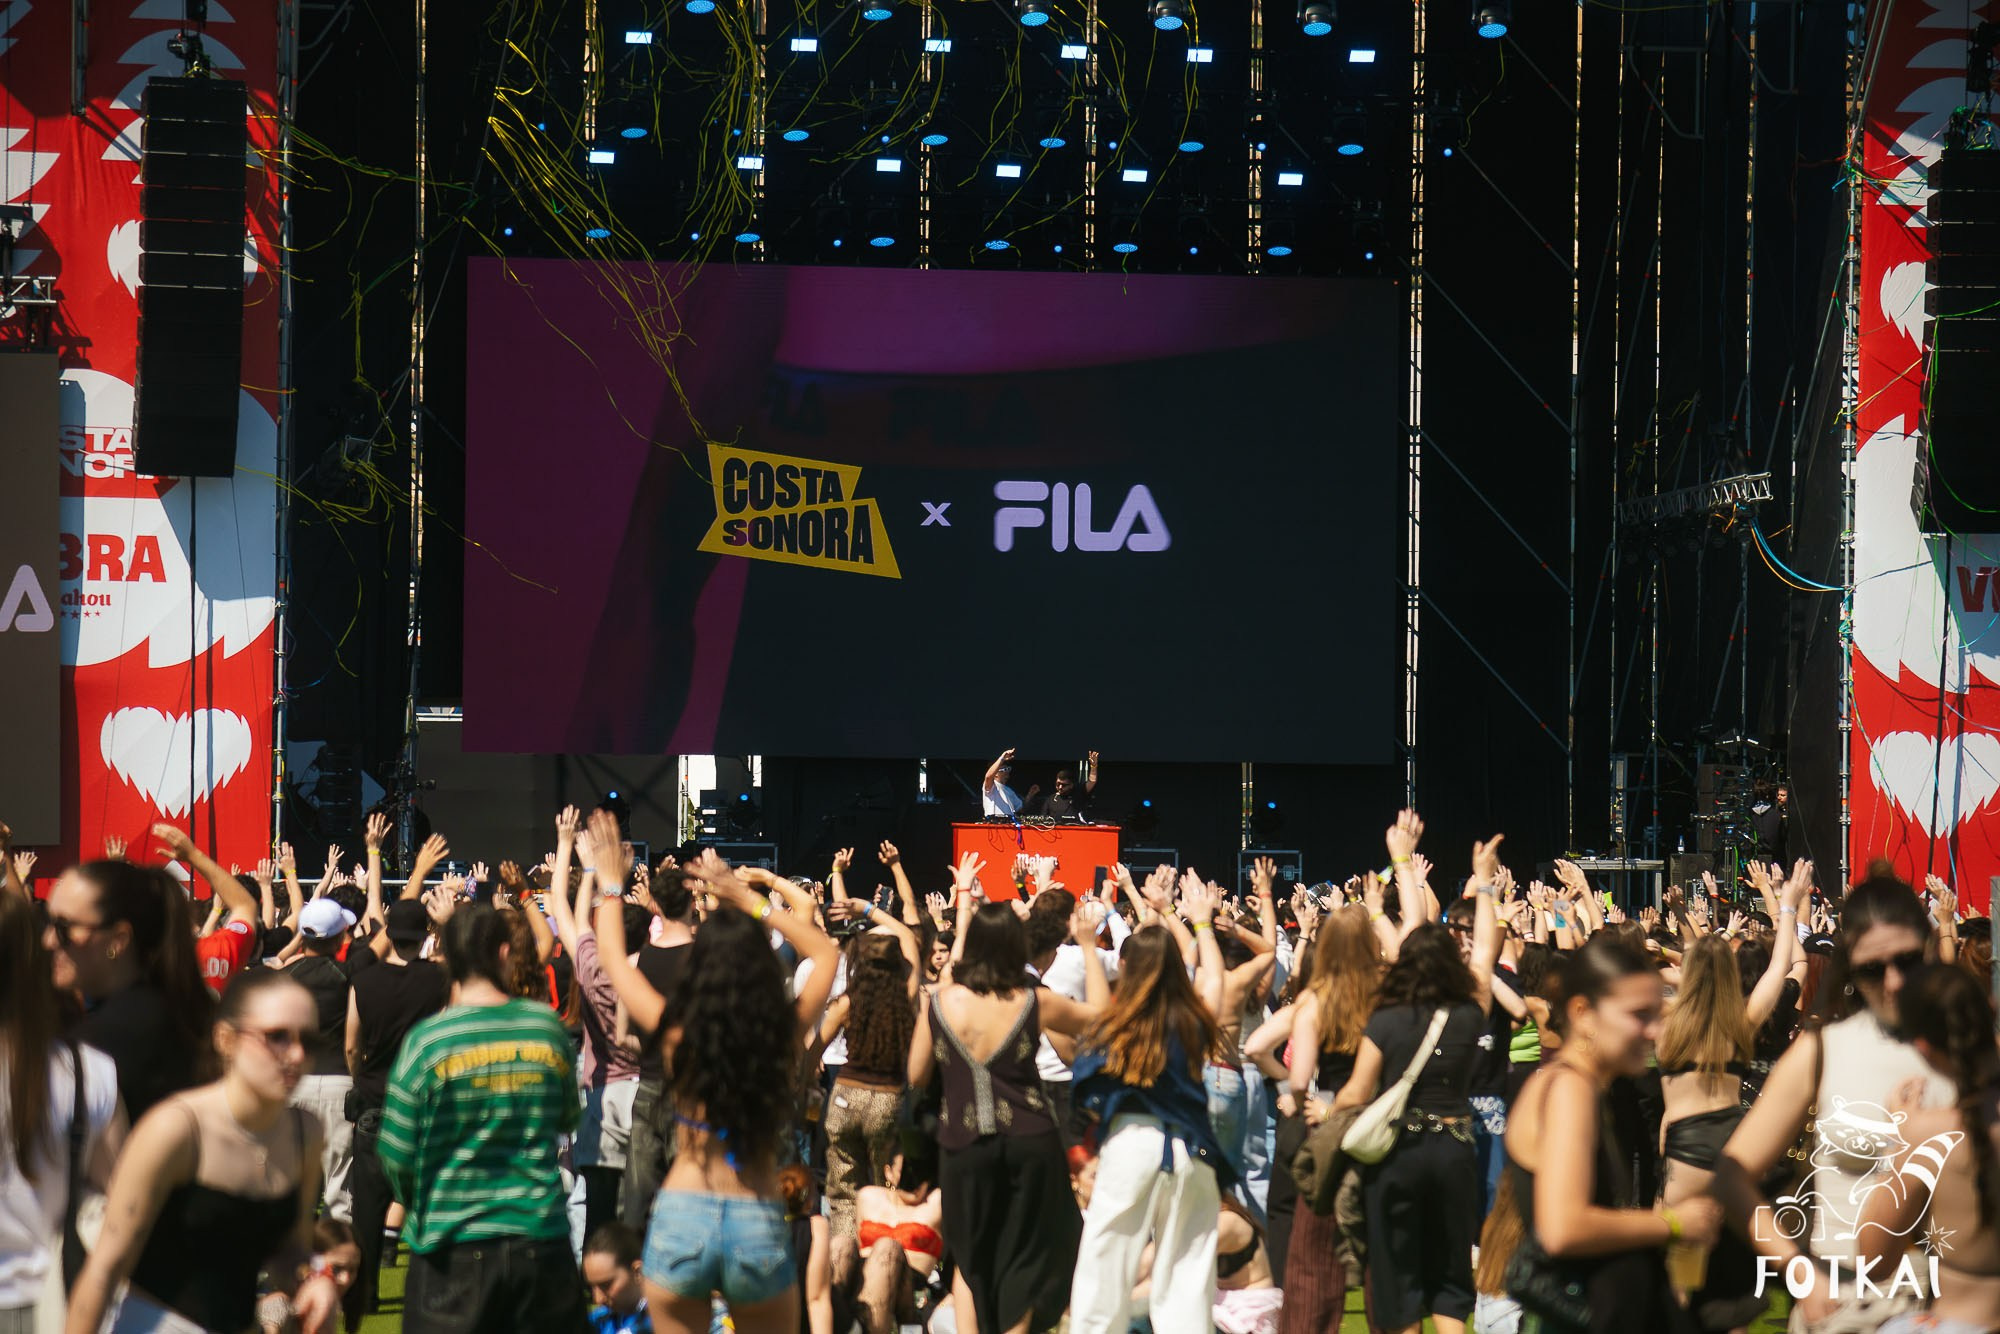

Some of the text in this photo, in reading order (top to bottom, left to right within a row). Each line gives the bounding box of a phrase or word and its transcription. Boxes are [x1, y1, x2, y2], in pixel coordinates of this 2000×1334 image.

[722, 457, 844, 515] COSTA
[994, 481, 1171, 552] FILA
[722, 504, 875, 565] SONORA
